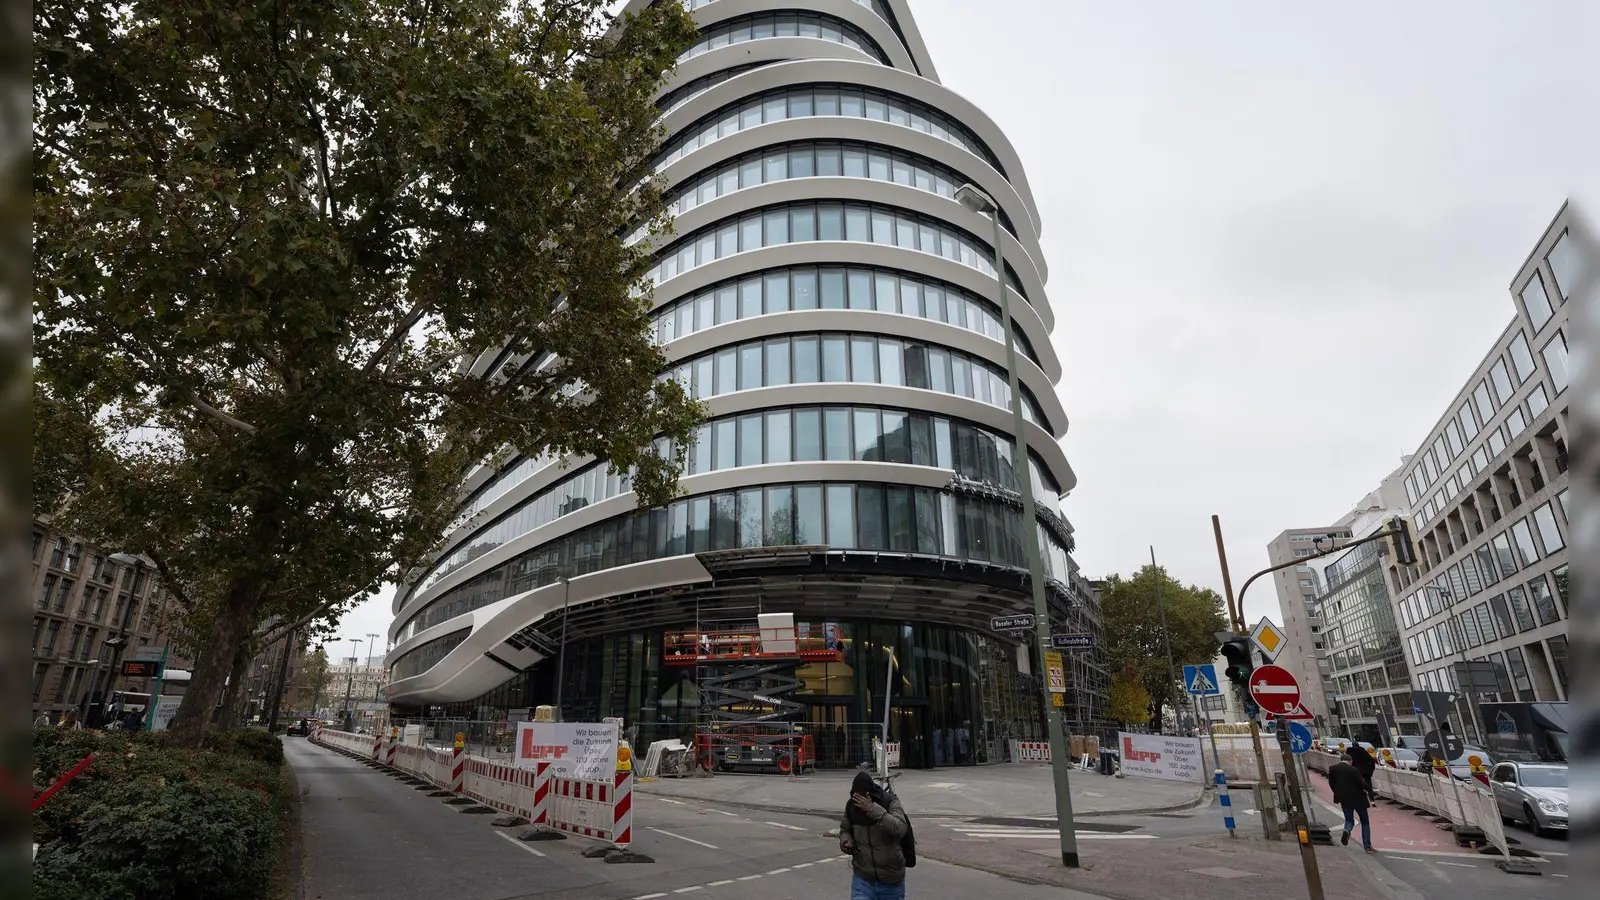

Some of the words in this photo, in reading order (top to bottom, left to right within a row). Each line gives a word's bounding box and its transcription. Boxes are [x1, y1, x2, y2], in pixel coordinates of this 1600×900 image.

[1013, 618, 1029, 626] Straße
[588, 729, 612, 737] bauen
[1174, 741, 1195, 749] bauen
[1125, 766, 1163, 775] www.lupp.de
[1179, 763, 1197, 771] Jahre
